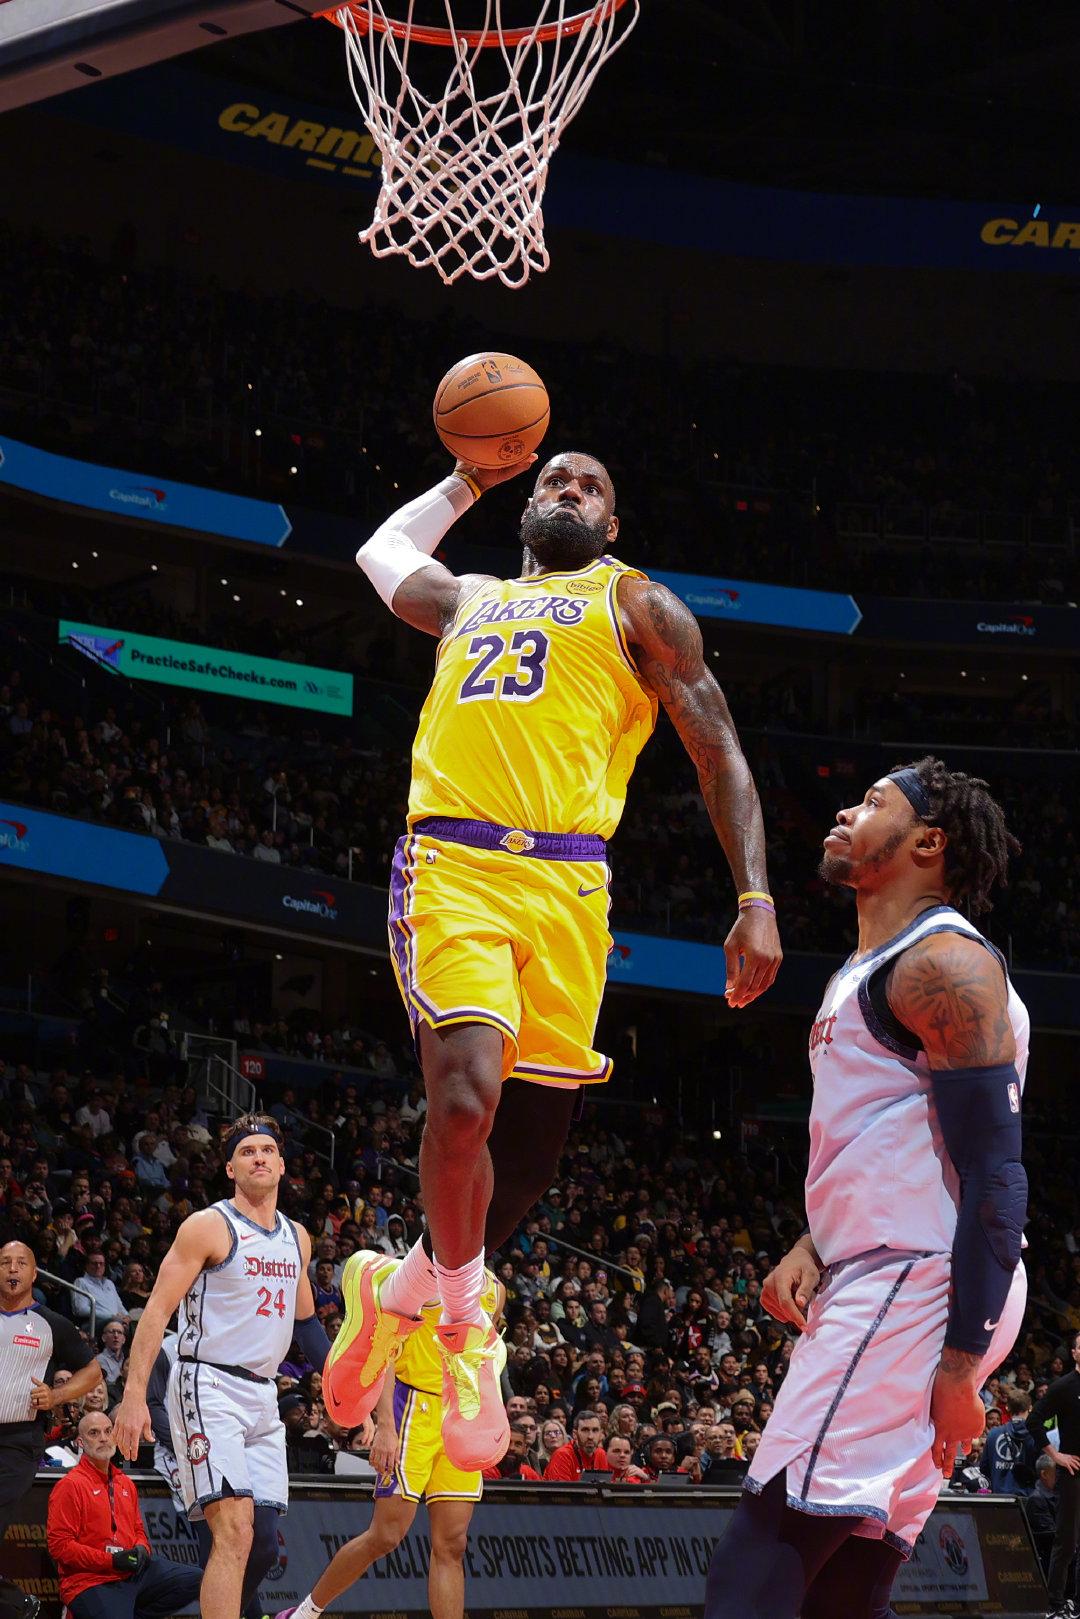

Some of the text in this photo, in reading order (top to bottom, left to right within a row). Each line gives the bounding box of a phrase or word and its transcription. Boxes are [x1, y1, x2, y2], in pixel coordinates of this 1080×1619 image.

[455, 596, 590, 639] LAKERS
[131, 648, 298, 691] PracticeSafeChecks.com
[457, 629, 550, 704] 23
[282, 895, 321, 914] Capital
[244, 1060, 262, 1075] 120
[244, 1256, 297, 1280] District
[256, 1286, 286, 1319] 24
[14, 1337, 39, 1346] Emirates
[477, 1535, 557, 1578] SPORTS
[553, 1535, 636, 1578] BETTING
[634, 1536, 668, 1577] APP
[669, 1537, 694, 1577] IN
